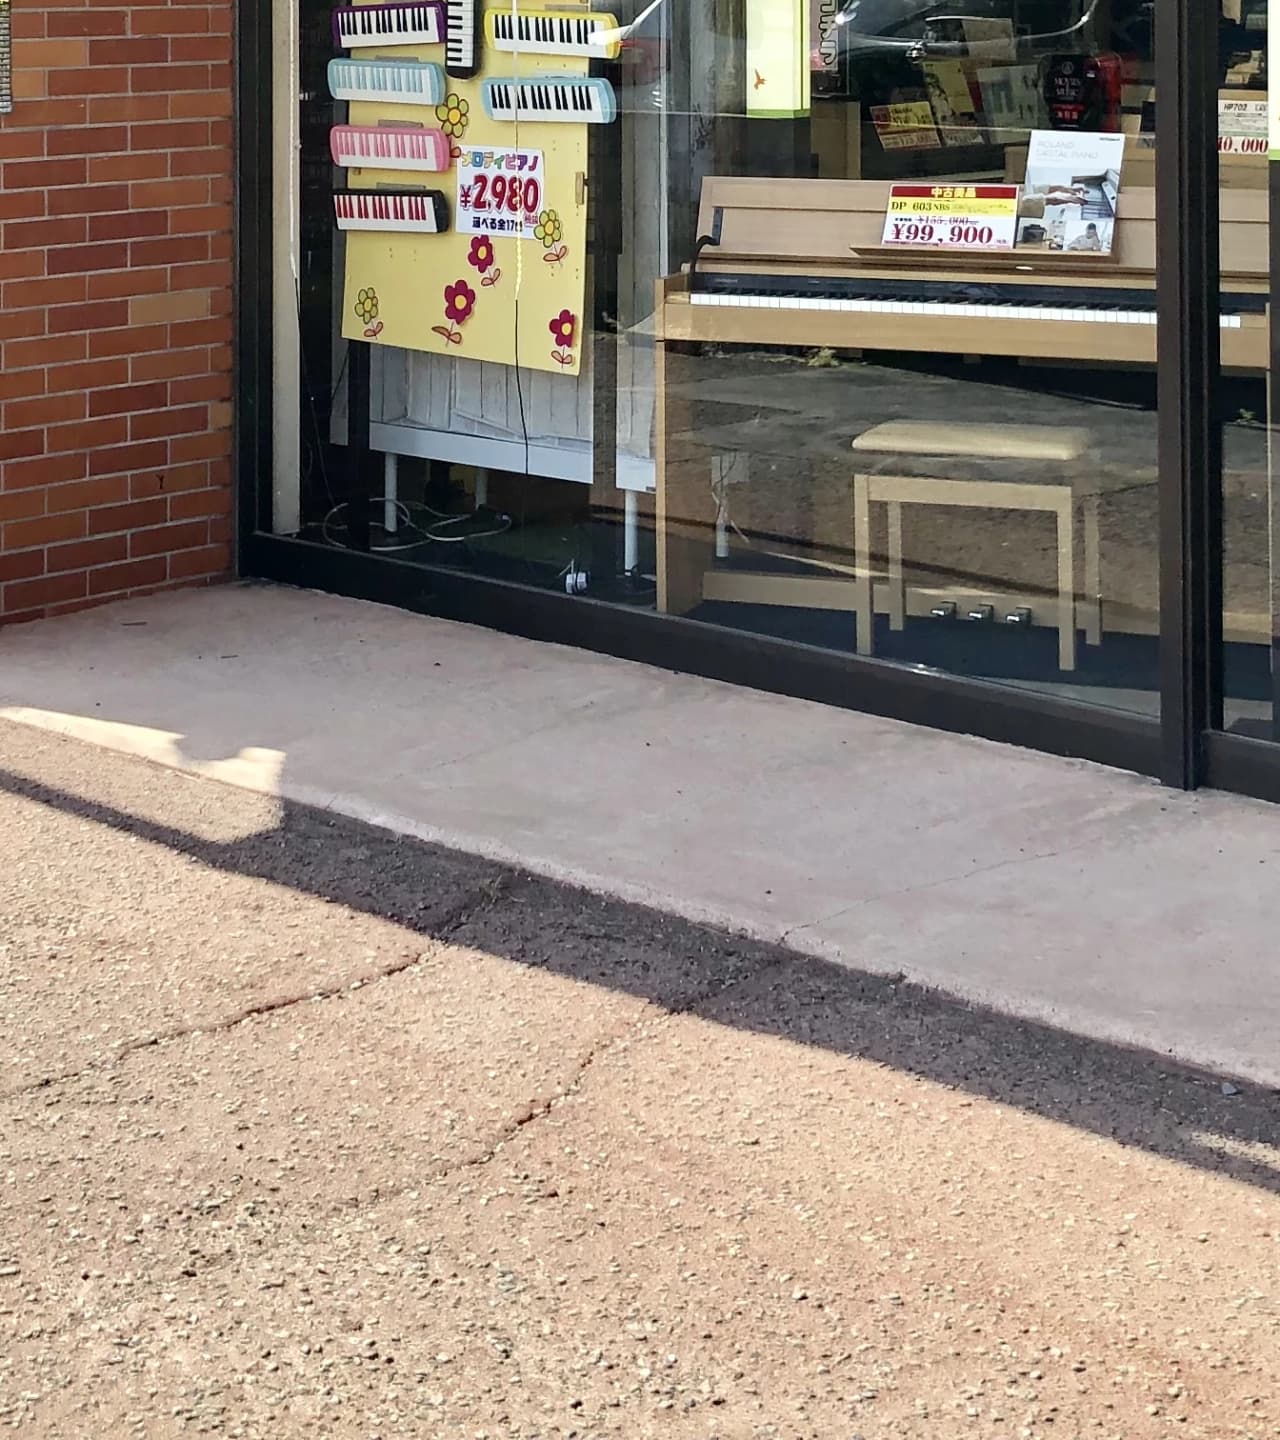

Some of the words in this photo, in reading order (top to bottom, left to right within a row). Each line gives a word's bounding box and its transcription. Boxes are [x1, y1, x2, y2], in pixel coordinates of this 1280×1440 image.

[461, 151, 539, 172] メロディピアノ
[461, 174, 540, 214] ¥2,980
[890, 200, 908, 210] DP
[891, 223, 994, 244] ¥99,900
